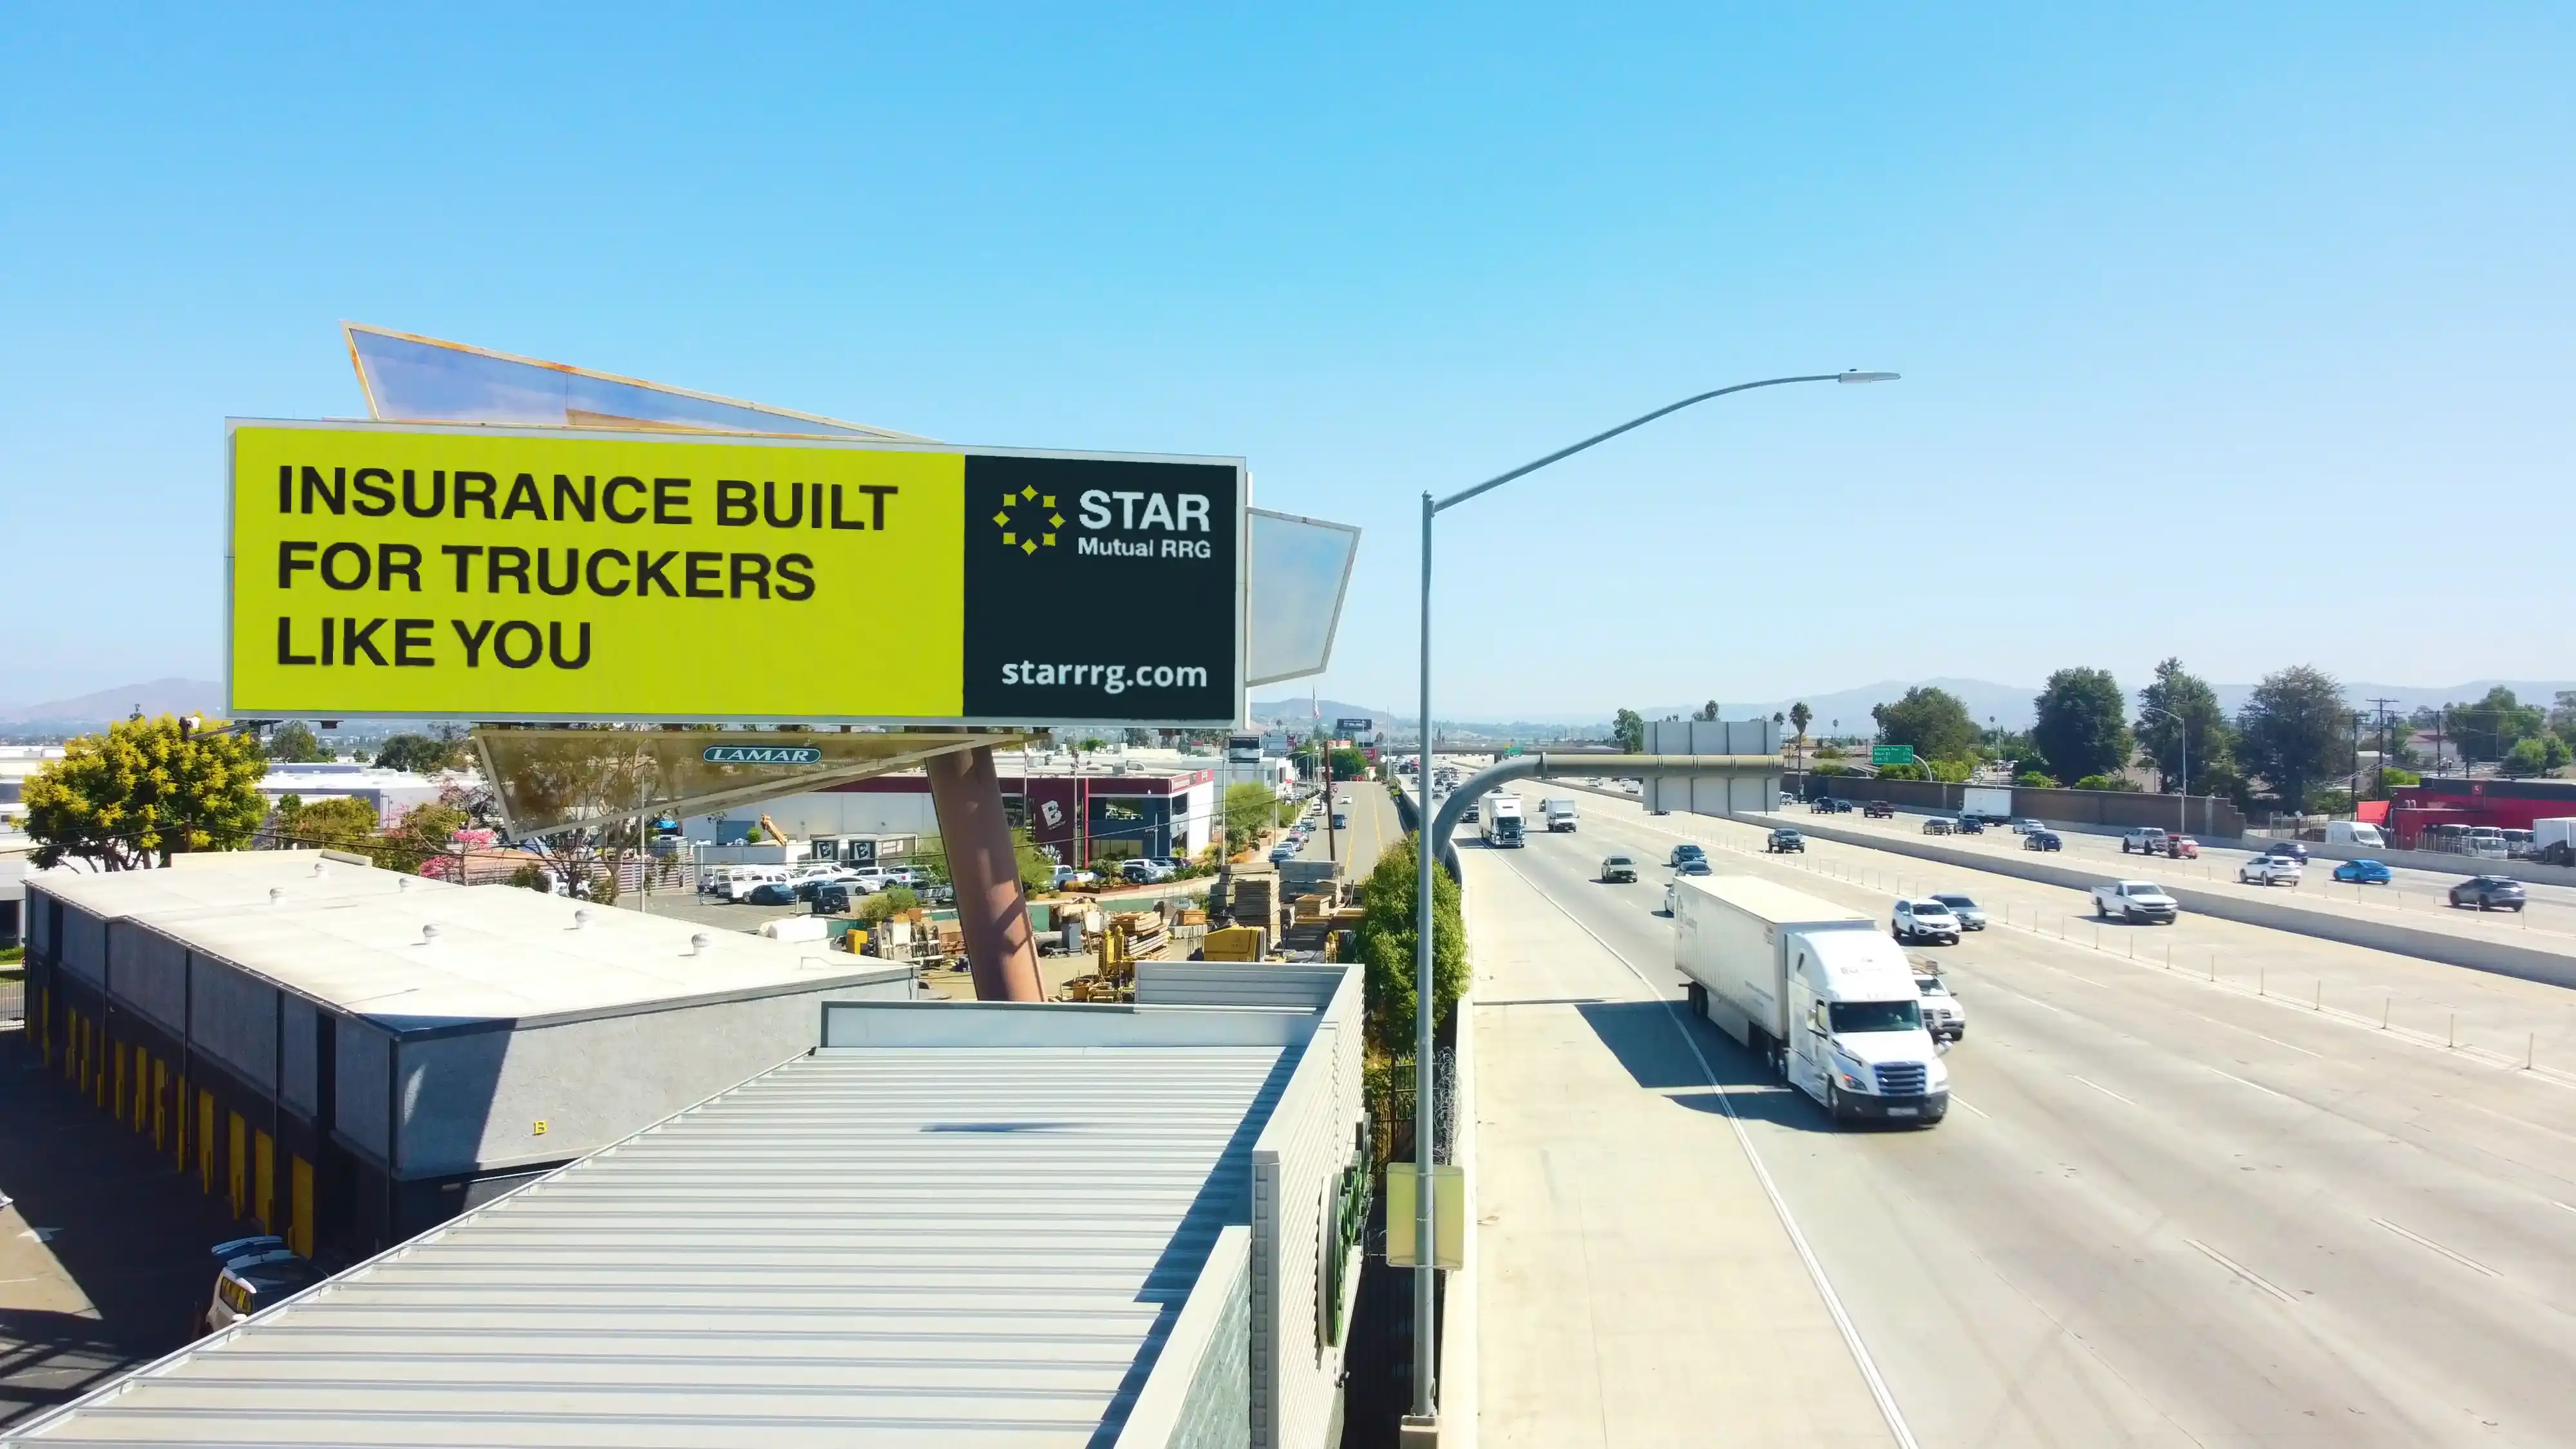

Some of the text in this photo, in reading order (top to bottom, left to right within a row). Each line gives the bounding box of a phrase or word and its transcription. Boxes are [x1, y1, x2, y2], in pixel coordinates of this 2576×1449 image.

[279, 465, 898, 531] INSURANCE BUILT
[1079, 489, 1211, 532] STAR
[1078, 537, 1211, 558] Mutual RRG
[278, 540, 815, 601] FOR TRUCKERS
[278, 616, 591, 670] LIKE YOU
[1001, 659, 1208, 694] starrrg.com
[713, 749, 809, 761] LAMAR
[534, 1121, 547, 1134] B
